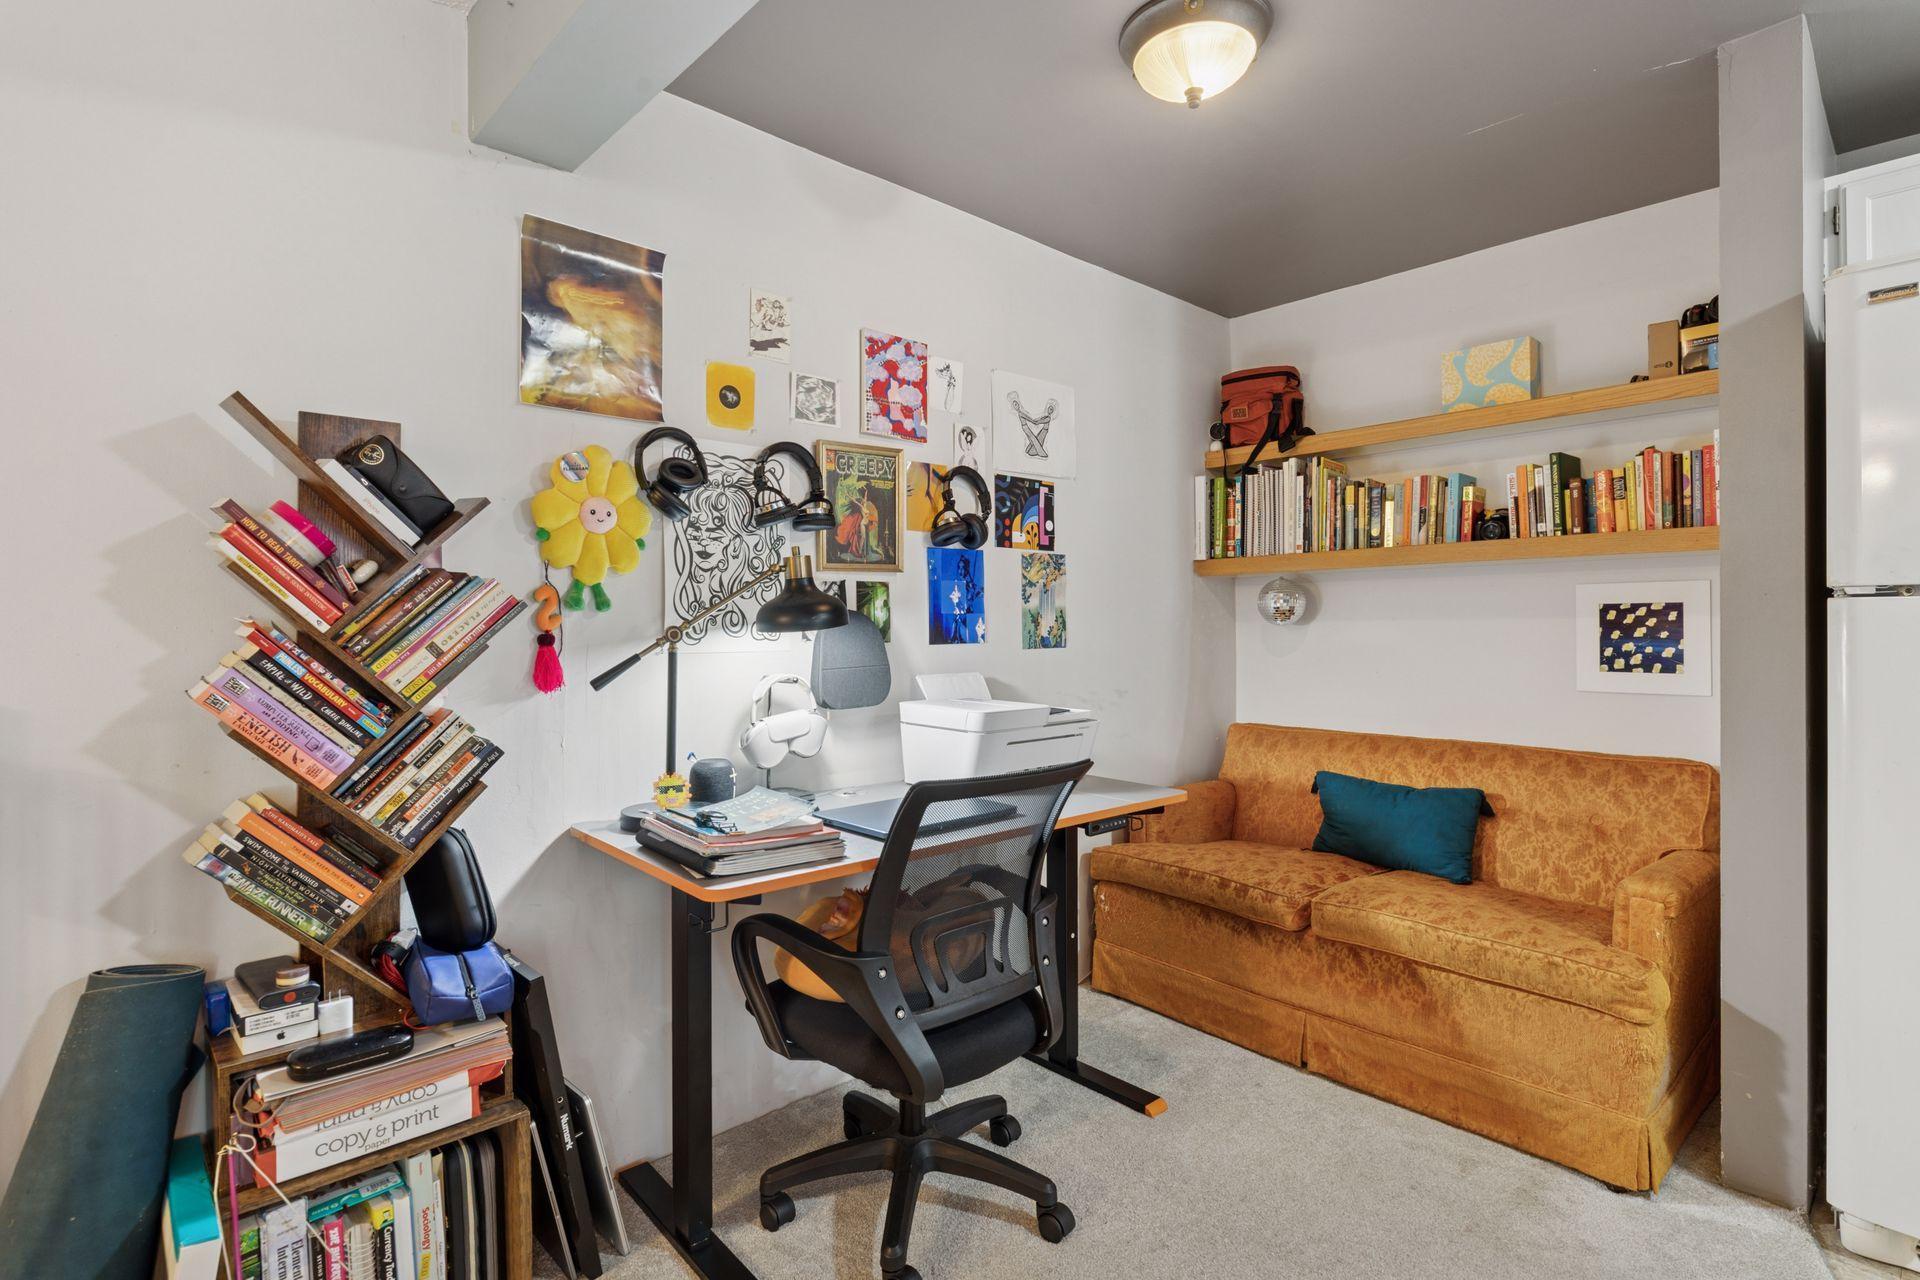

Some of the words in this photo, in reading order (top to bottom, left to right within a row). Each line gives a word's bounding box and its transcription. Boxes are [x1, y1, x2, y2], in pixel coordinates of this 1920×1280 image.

[836, 453, 895, 479] CREEPY
[240, 515, 258, 531] HOW
[256, 528, 268, 540] TO
[265, 536, 284, 554] READ
[282, 550, 304, 571] TAROT
[440, 610, 480, 647] PLACEBO
[275, 652, 305, 676] PAINLESS
[303, 673, 347, 708] VOCABULARY
[404, 676, 424, 695] USED
[413, 682, 433, 701] USED
[259, 658, 286, 680] EMPIRE
[289, 680, 313, 701] WILD
[319, 704, 340, 721] CHERIE
[338, 718, 363, 739] DIMALINE
[231, 719, 265, 745] LANGUAGE
[235, 709, 291, 754] ENGLISH
[269, 715, 300, 740] CODING
[471, 760, 489, 779] Shades
[486, 750, 500, 764] Fifty
[419, 758, 454, 794] MONTANA
[455, 780, 469, 795] Grey
[466, 775, 474, 784] of
[404, 791, 421, 808] 1948
[242, 835, 262, 851] SWIM
[260, 847, 281, 864] HOME
[280, 863, 290, 871] THE
[290, 867, 319, 888] VANISHED
[249, 854, 273, 872] NIGHT
[272, 869, 298, 887] FLYING
[297, 885, 324, 905] WOMAN
[236, 878, 268, 903] MAZE
[264, 894, 307, 926] RUNNER
[315, 1115, 369, 1157] copy
[376, 1119, 387, 1136] &
[391, 1104, 439, 1136] print
[364, 1136, 391, 1152] paper
[559, 1113, 574, 1151] Numark
[328, 1227, 340, 1246] THE
[384, 1226, 393, 1263] Currency
[422, 1206, 431, 1250] Sociology
